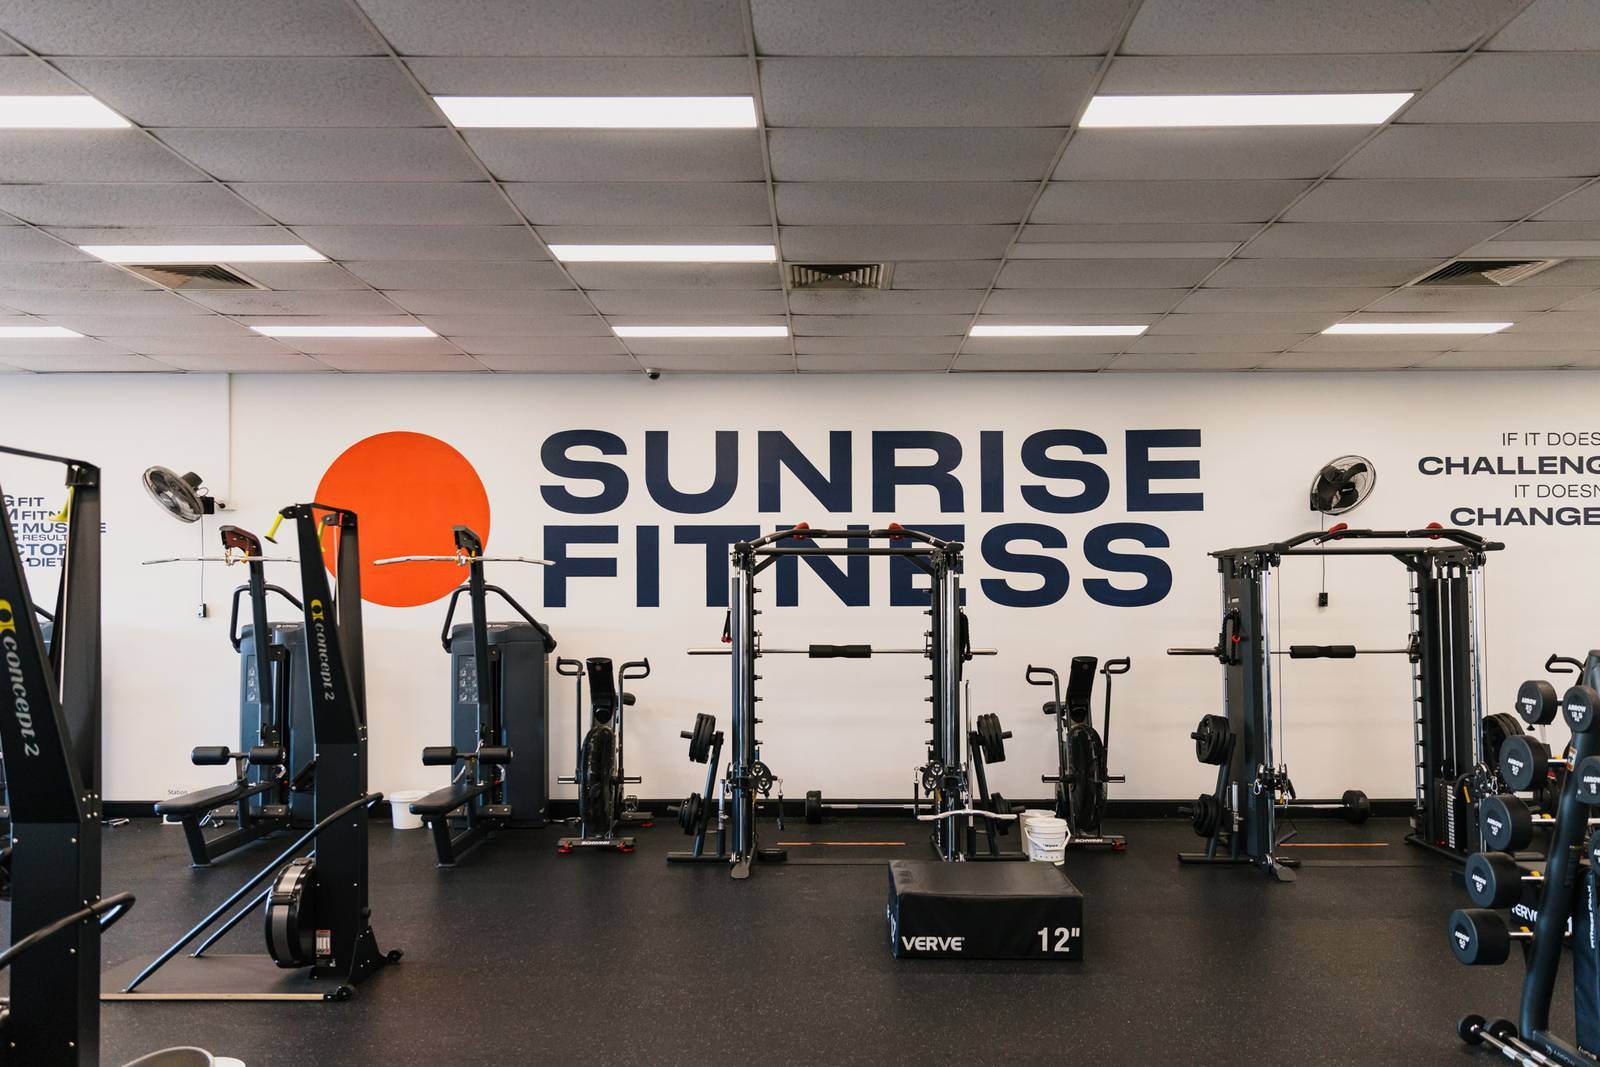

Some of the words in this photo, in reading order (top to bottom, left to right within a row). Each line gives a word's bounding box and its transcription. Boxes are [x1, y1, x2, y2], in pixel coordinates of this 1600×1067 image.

[1502, 432, 1518, 446] IF
[1525, 432, 1541, 446] IT
[540, 429, 1204, 514] SUNRISE
[1514, 484, 1531, 498] IT
[18, 497, 44, 507] FIT
[543, 522, 1173, 607] FITNESS
[315, 622, 333, 688] concept
[325, 692, 335, 700] 2
[3, 636, 35, 738] concept
[24, 743, 40, 756] 2
[1567, 703, 1587, 713] ARROW
[1507, 757, 1524, 768] ARROW
[902, 936, 964, 952] VERVE
[1038, 926, 1081, 953] 12"
